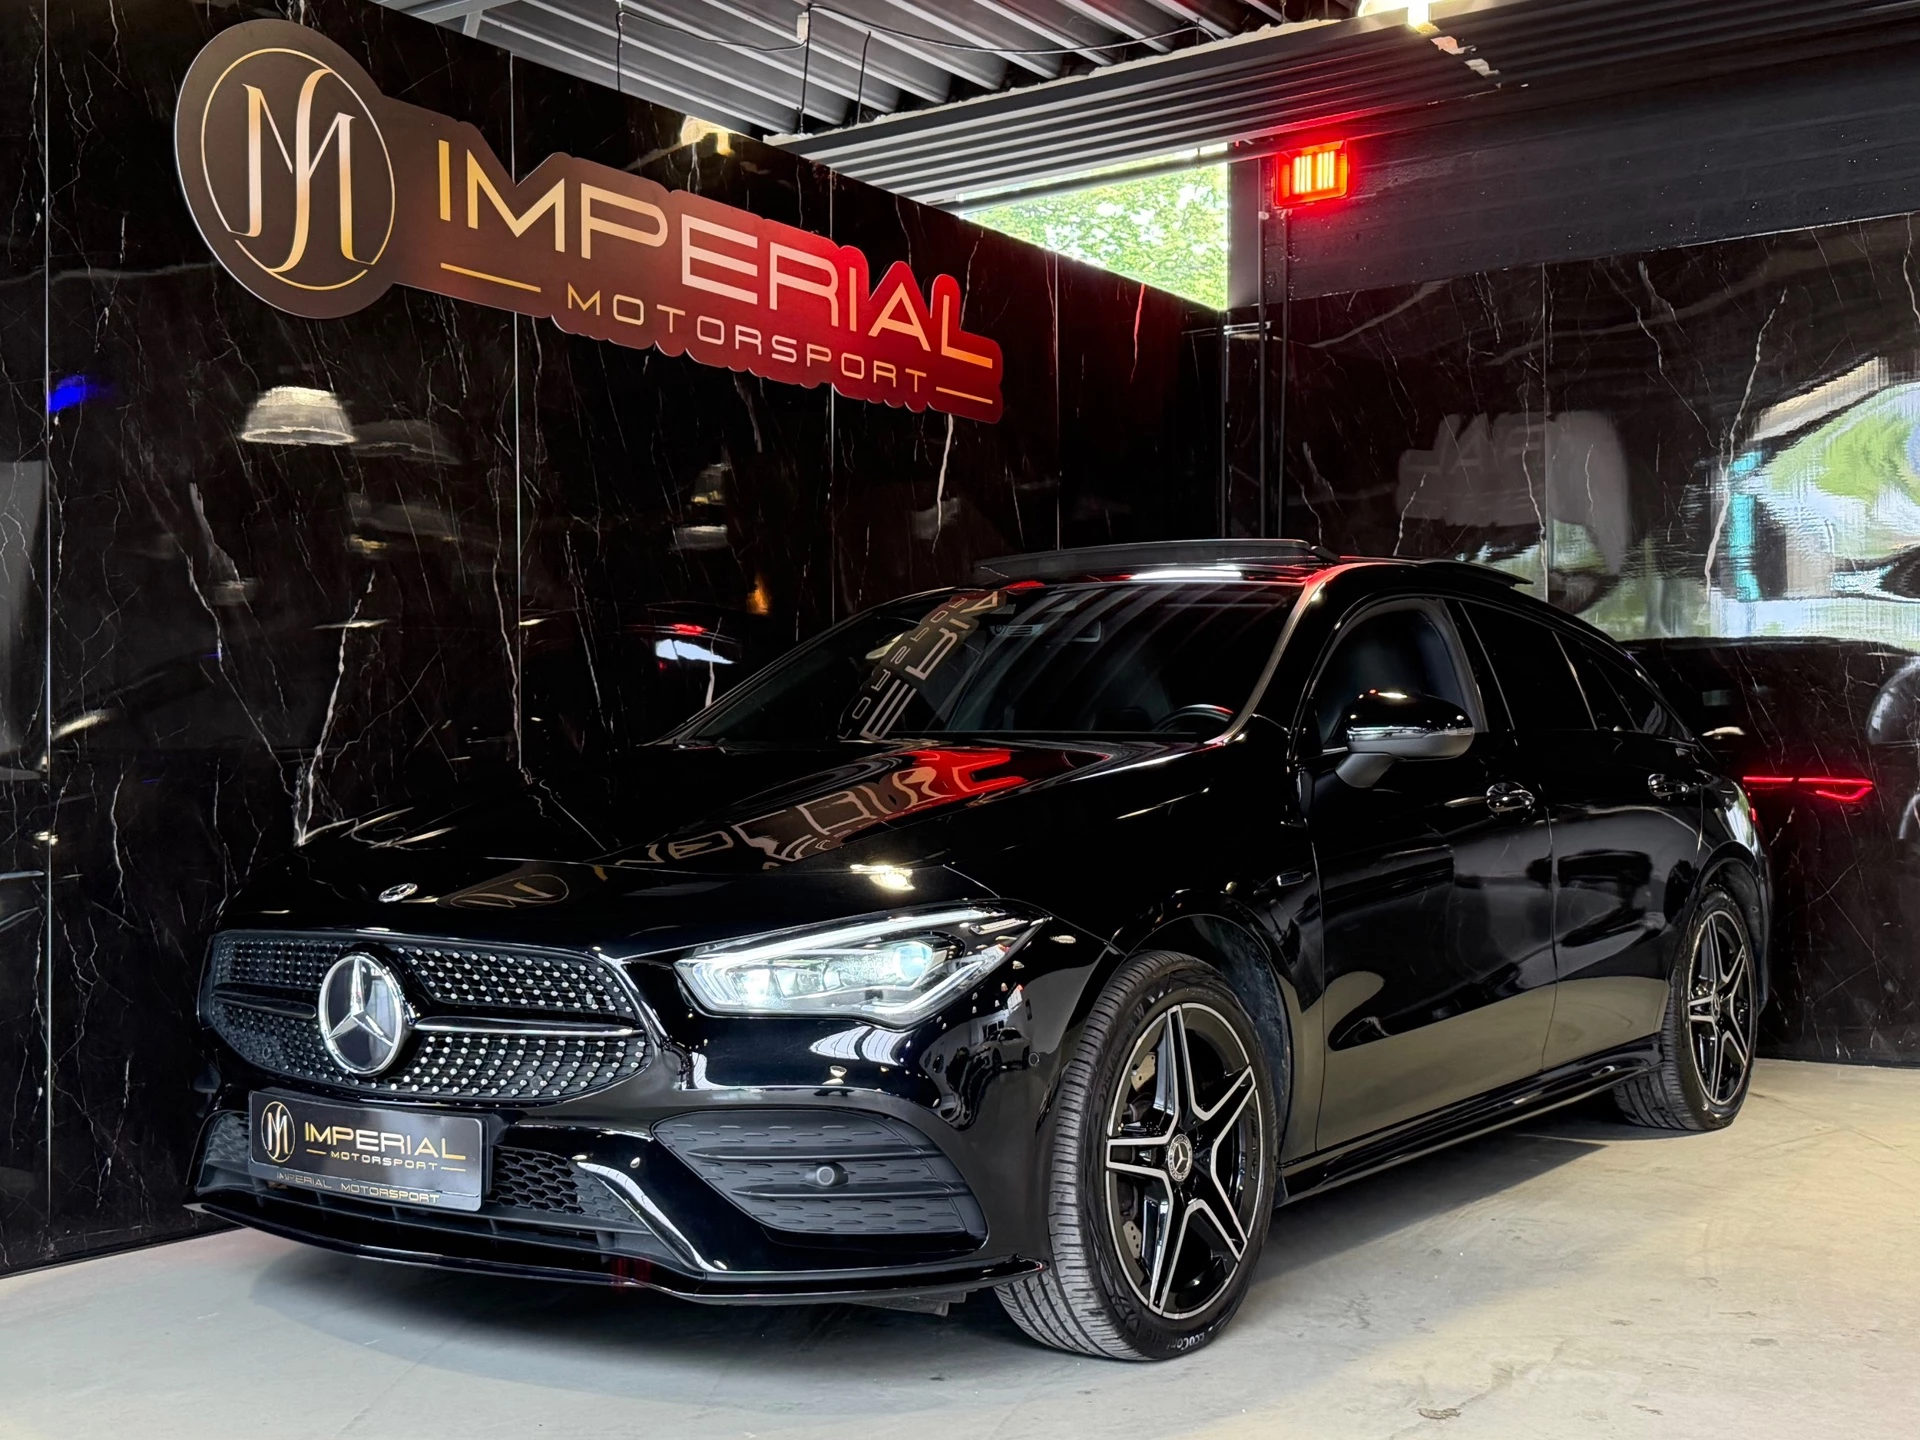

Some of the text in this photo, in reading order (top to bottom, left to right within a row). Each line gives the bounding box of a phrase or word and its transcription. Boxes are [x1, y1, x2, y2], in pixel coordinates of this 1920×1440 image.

[438, 139, 993, 369] IMPERIAL
[567, 282, 928, 393] MOTORSPORT
[304, 1121, 467, 1161] IMPERIAL
[330, 1150, 439, 1171] MOTORSPORT
[276, 1172, 440, 1204] IMPERIAL MOTORSPORT
